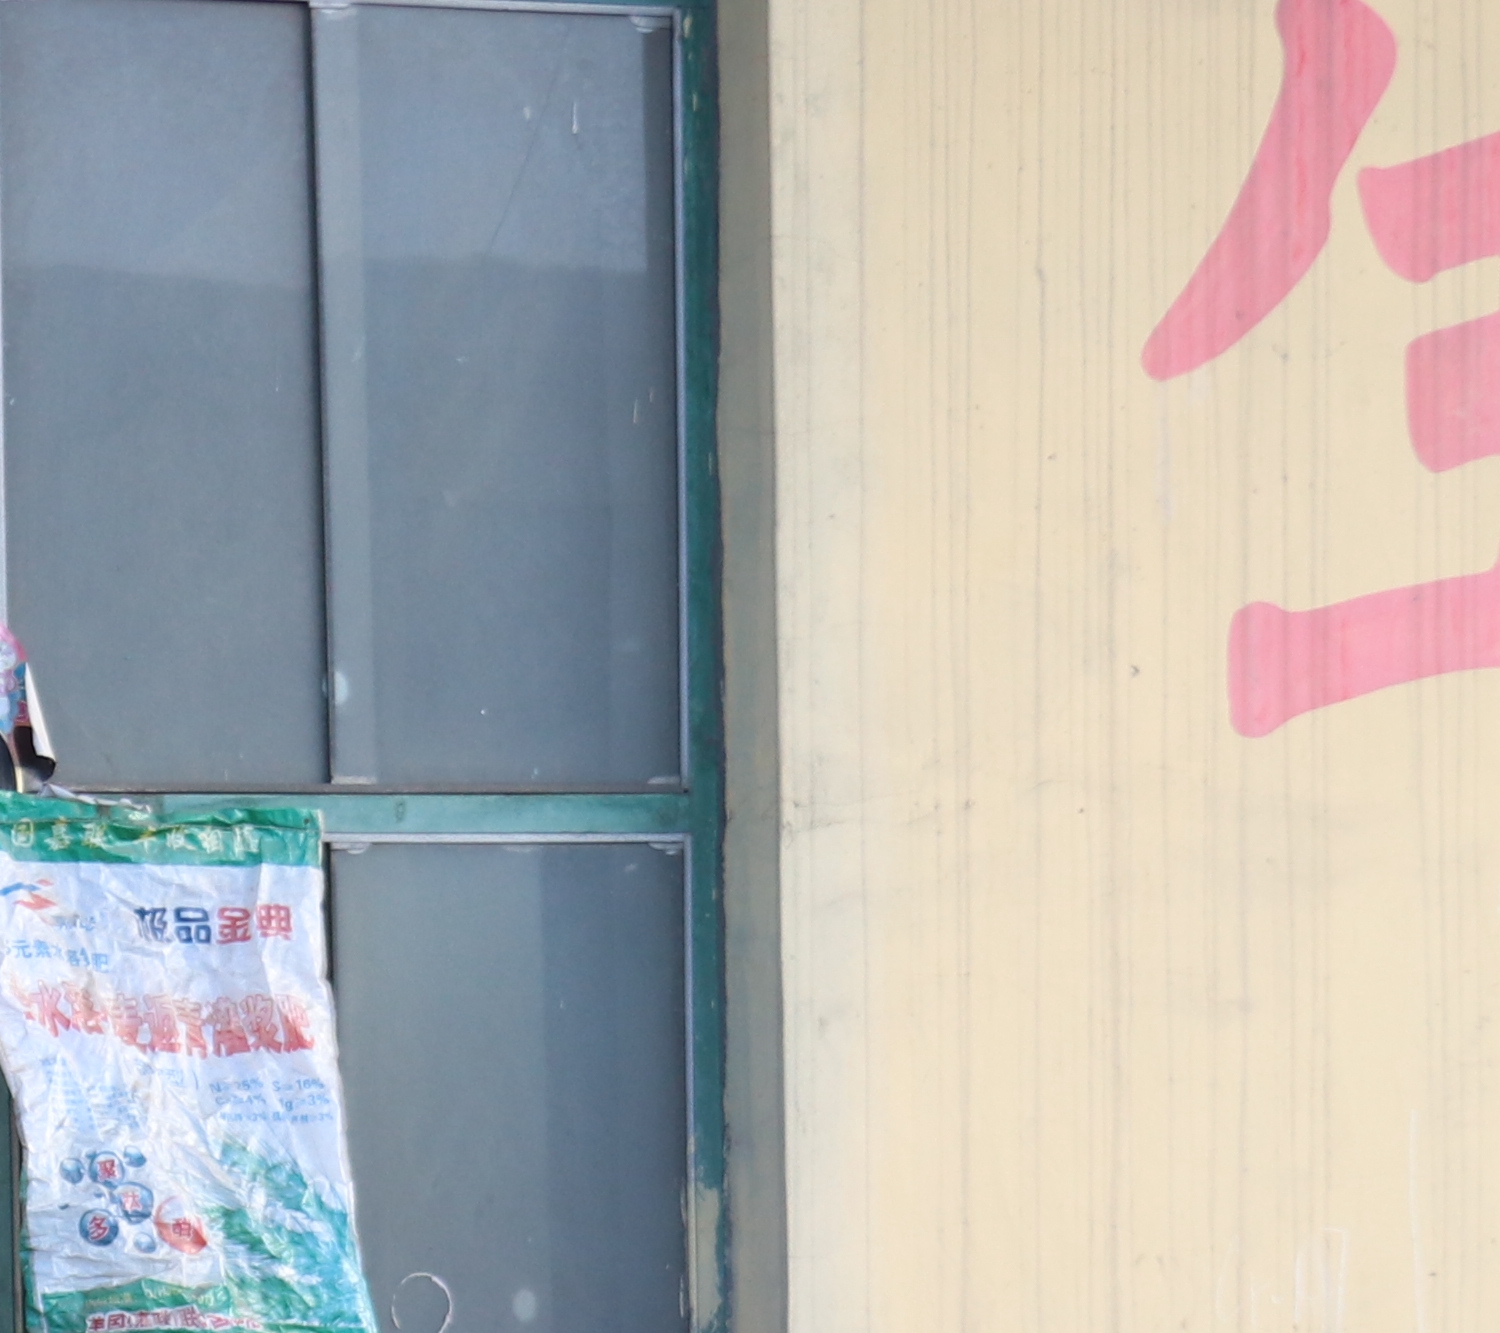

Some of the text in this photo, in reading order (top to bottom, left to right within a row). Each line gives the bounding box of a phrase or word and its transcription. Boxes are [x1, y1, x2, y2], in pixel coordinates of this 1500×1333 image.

[134, 904, 294, 947] 极品金典
[88, 1216, 109, 1240] 多
